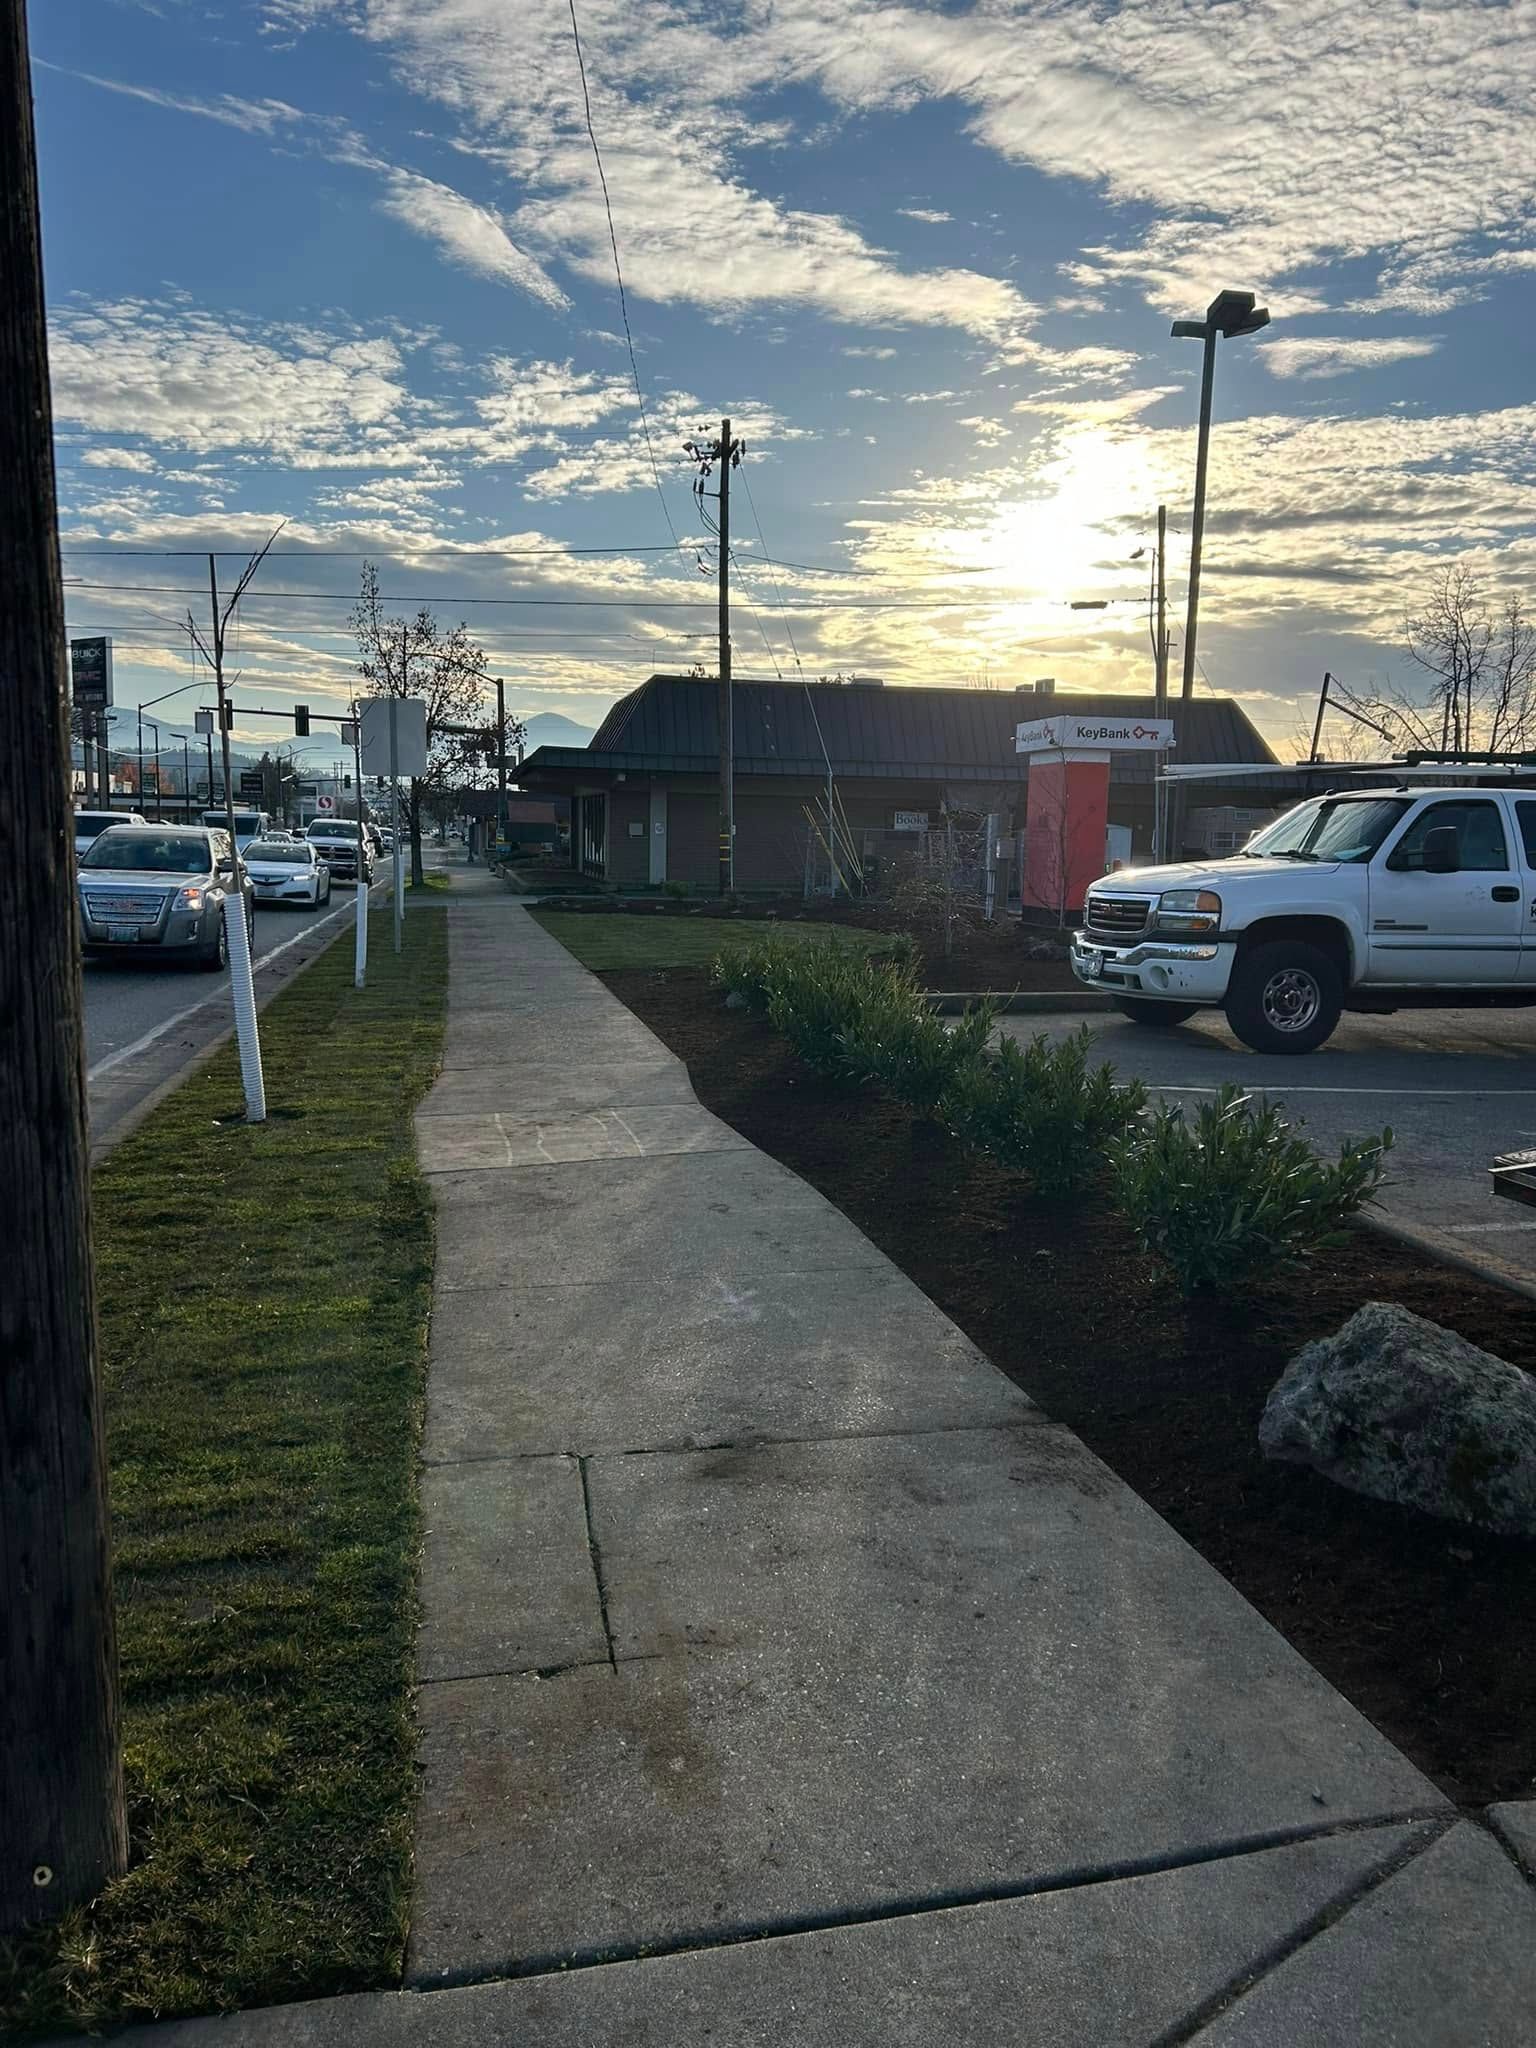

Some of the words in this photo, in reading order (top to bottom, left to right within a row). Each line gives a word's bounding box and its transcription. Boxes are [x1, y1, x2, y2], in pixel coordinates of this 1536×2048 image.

[72, 648, 103, 659] BUICK
[1077, 726, 1131, 740] KeyBank
[896, 813, 928, 825] Books
